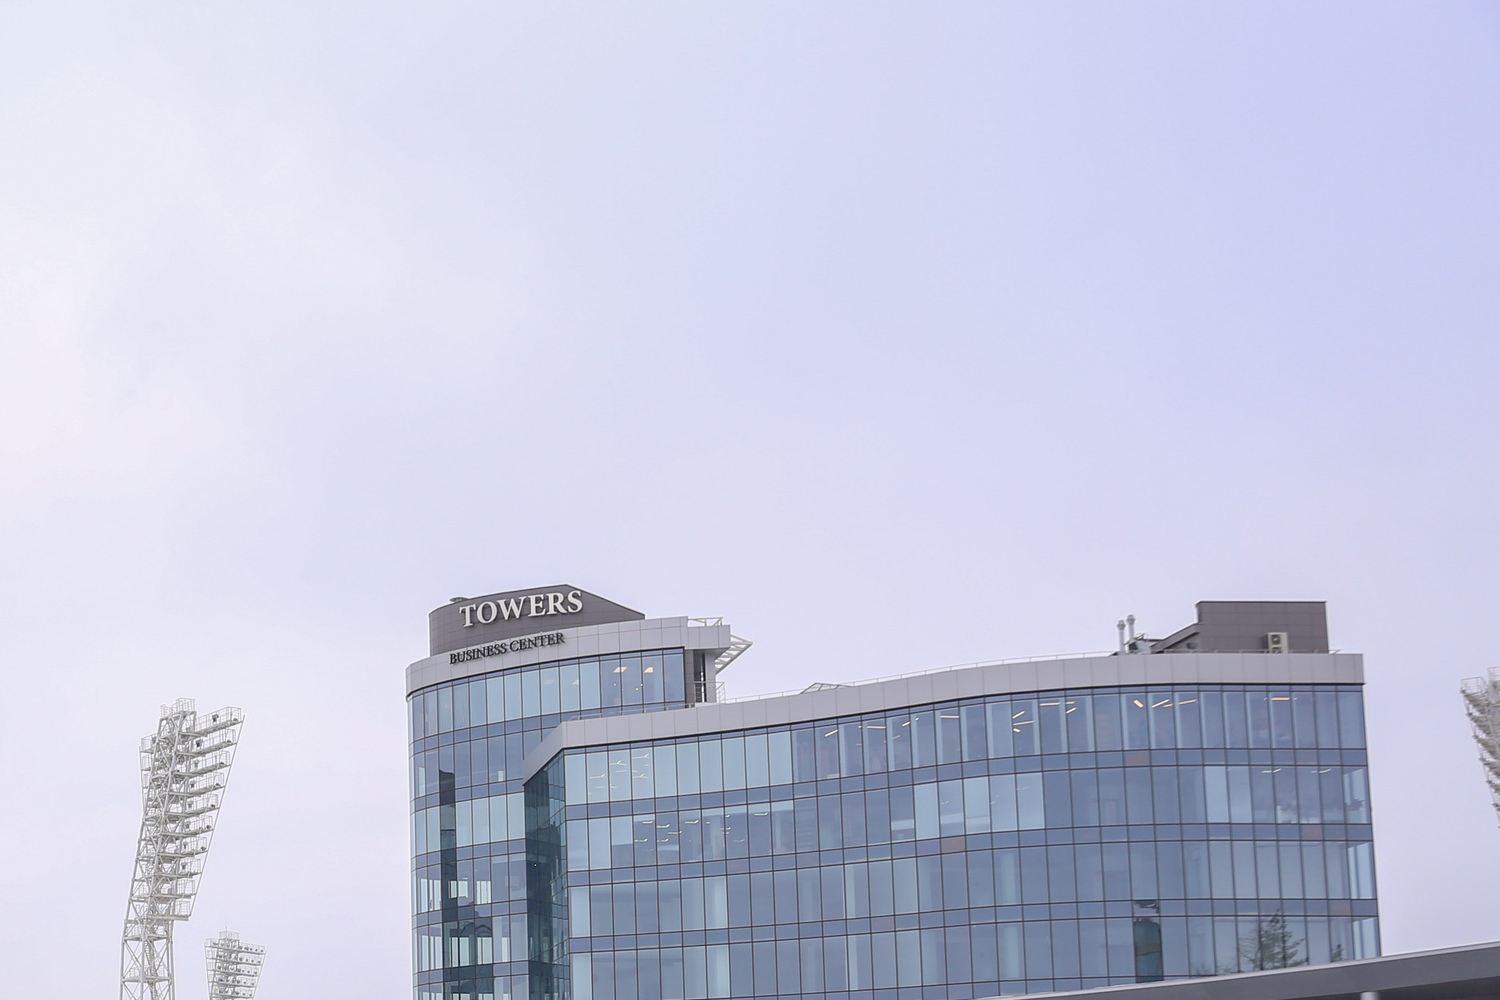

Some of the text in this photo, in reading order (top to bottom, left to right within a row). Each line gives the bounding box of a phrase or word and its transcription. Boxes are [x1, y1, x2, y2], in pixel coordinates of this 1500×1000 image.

[459, 590, 583, 628] TOWERS
[450, 632, 565, 665] BUSINESS CENTER
